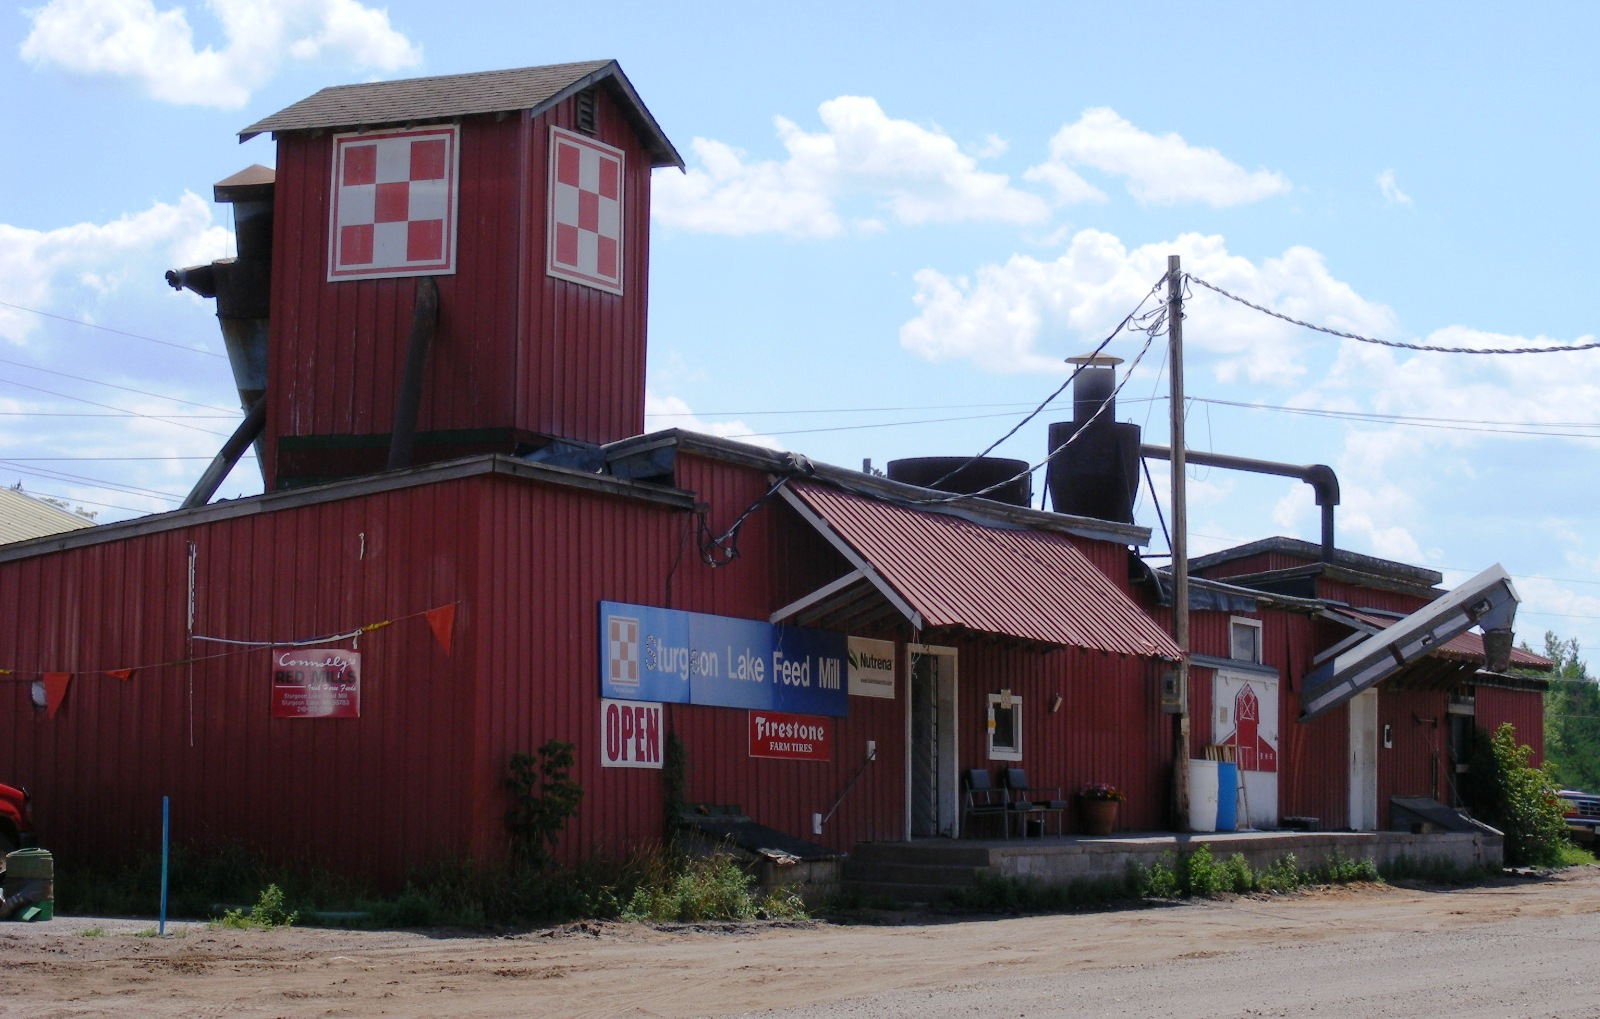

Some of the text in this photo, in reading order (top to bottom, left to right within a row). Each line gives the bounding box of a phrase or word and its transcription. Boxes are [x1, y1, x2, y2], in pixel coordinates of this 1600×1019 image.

[279, 652, 356, 678] Connolly's
[645, 635, 840, 690] Sturgeon Lake Feed Mill
[861, 652, 892, 671] Nutrena
[276, 670, 356, 684] RED MILLS
[606, 703, 659, 763] OPEN
[755, 716, 825, 742] Firestone
[770, 741, 813, 753] FARM TIRES
